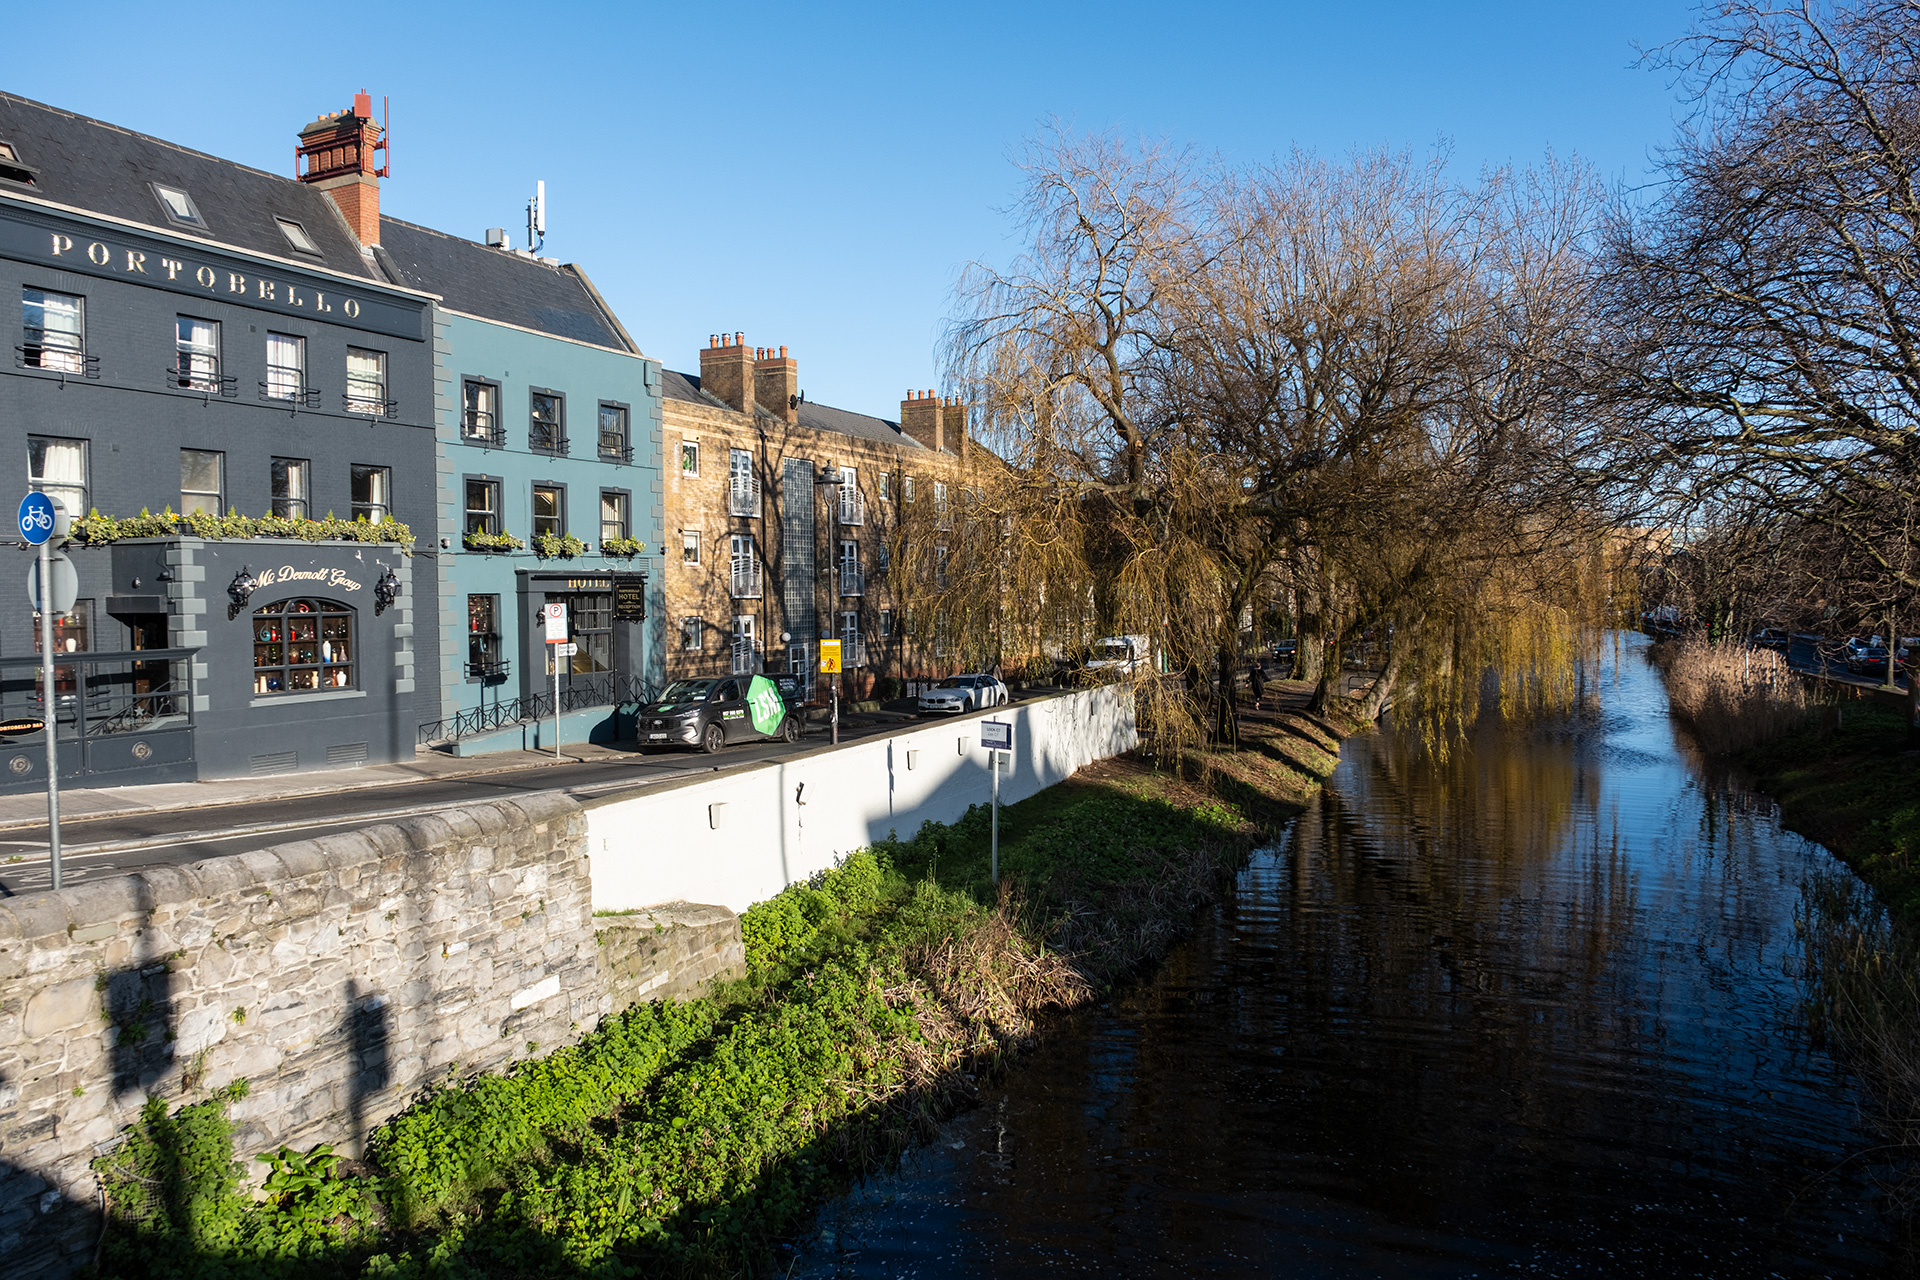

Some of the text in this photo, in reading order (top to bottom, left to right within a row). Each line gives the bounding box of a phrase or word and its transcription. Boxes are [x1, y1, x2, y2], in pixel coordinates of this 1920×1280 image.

[51, 233, 360, 319] PORTOBELLO
[277, 565, 329, 583] Dermott
[328, 568, 362, 592] Group
[553, 606, 559, 614] P
